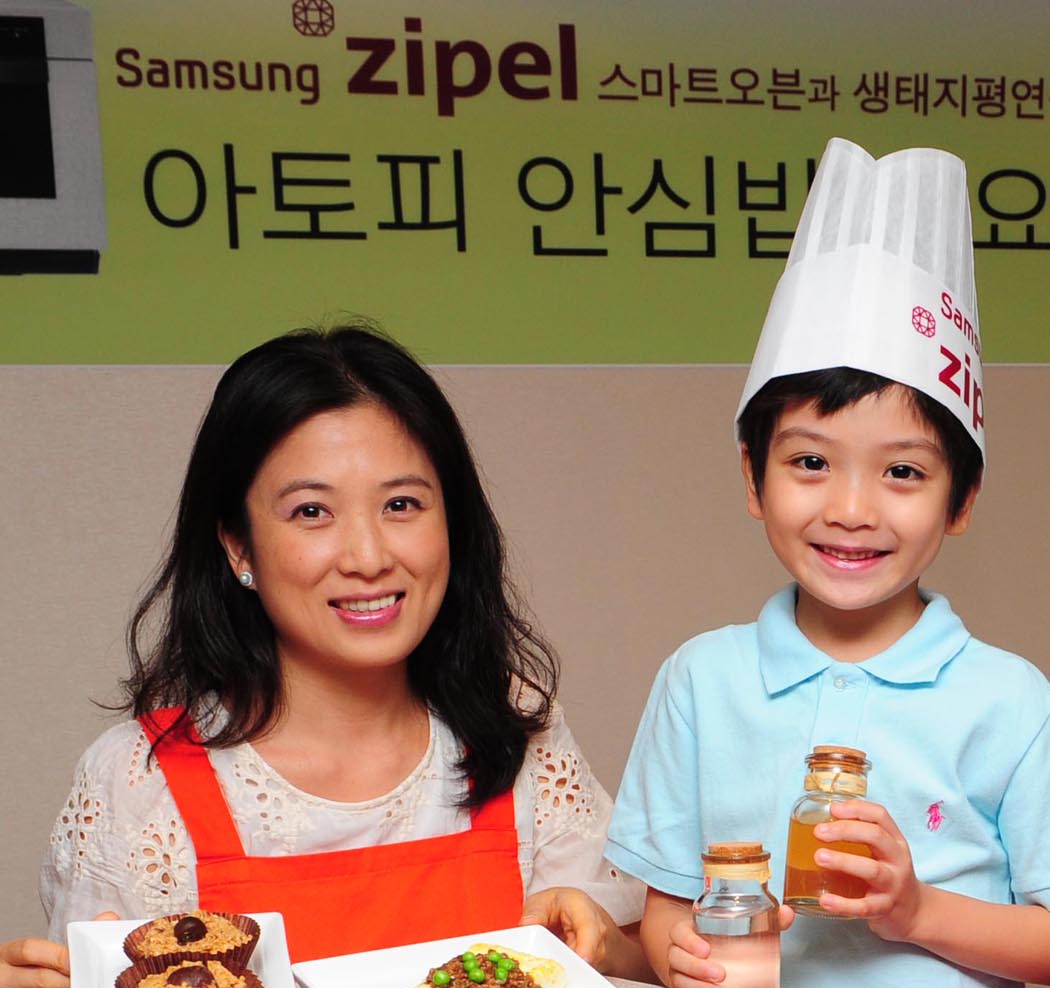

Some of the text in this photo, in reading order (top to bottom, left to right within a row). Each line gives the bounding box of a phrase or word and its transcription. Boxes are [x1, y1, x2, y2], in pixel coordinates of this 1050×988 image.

[114, 47, 321, 105] Samsung
[345, 16, 579, 118] zipel
[597, 62, 840, 112] 스마트오븐과
[143, 143, 468, 253] 아토피
[516, 151, 818, 259] 안심밥
[940, 291, 982, 355] Sams
[938, 344, 985, 432] zip
